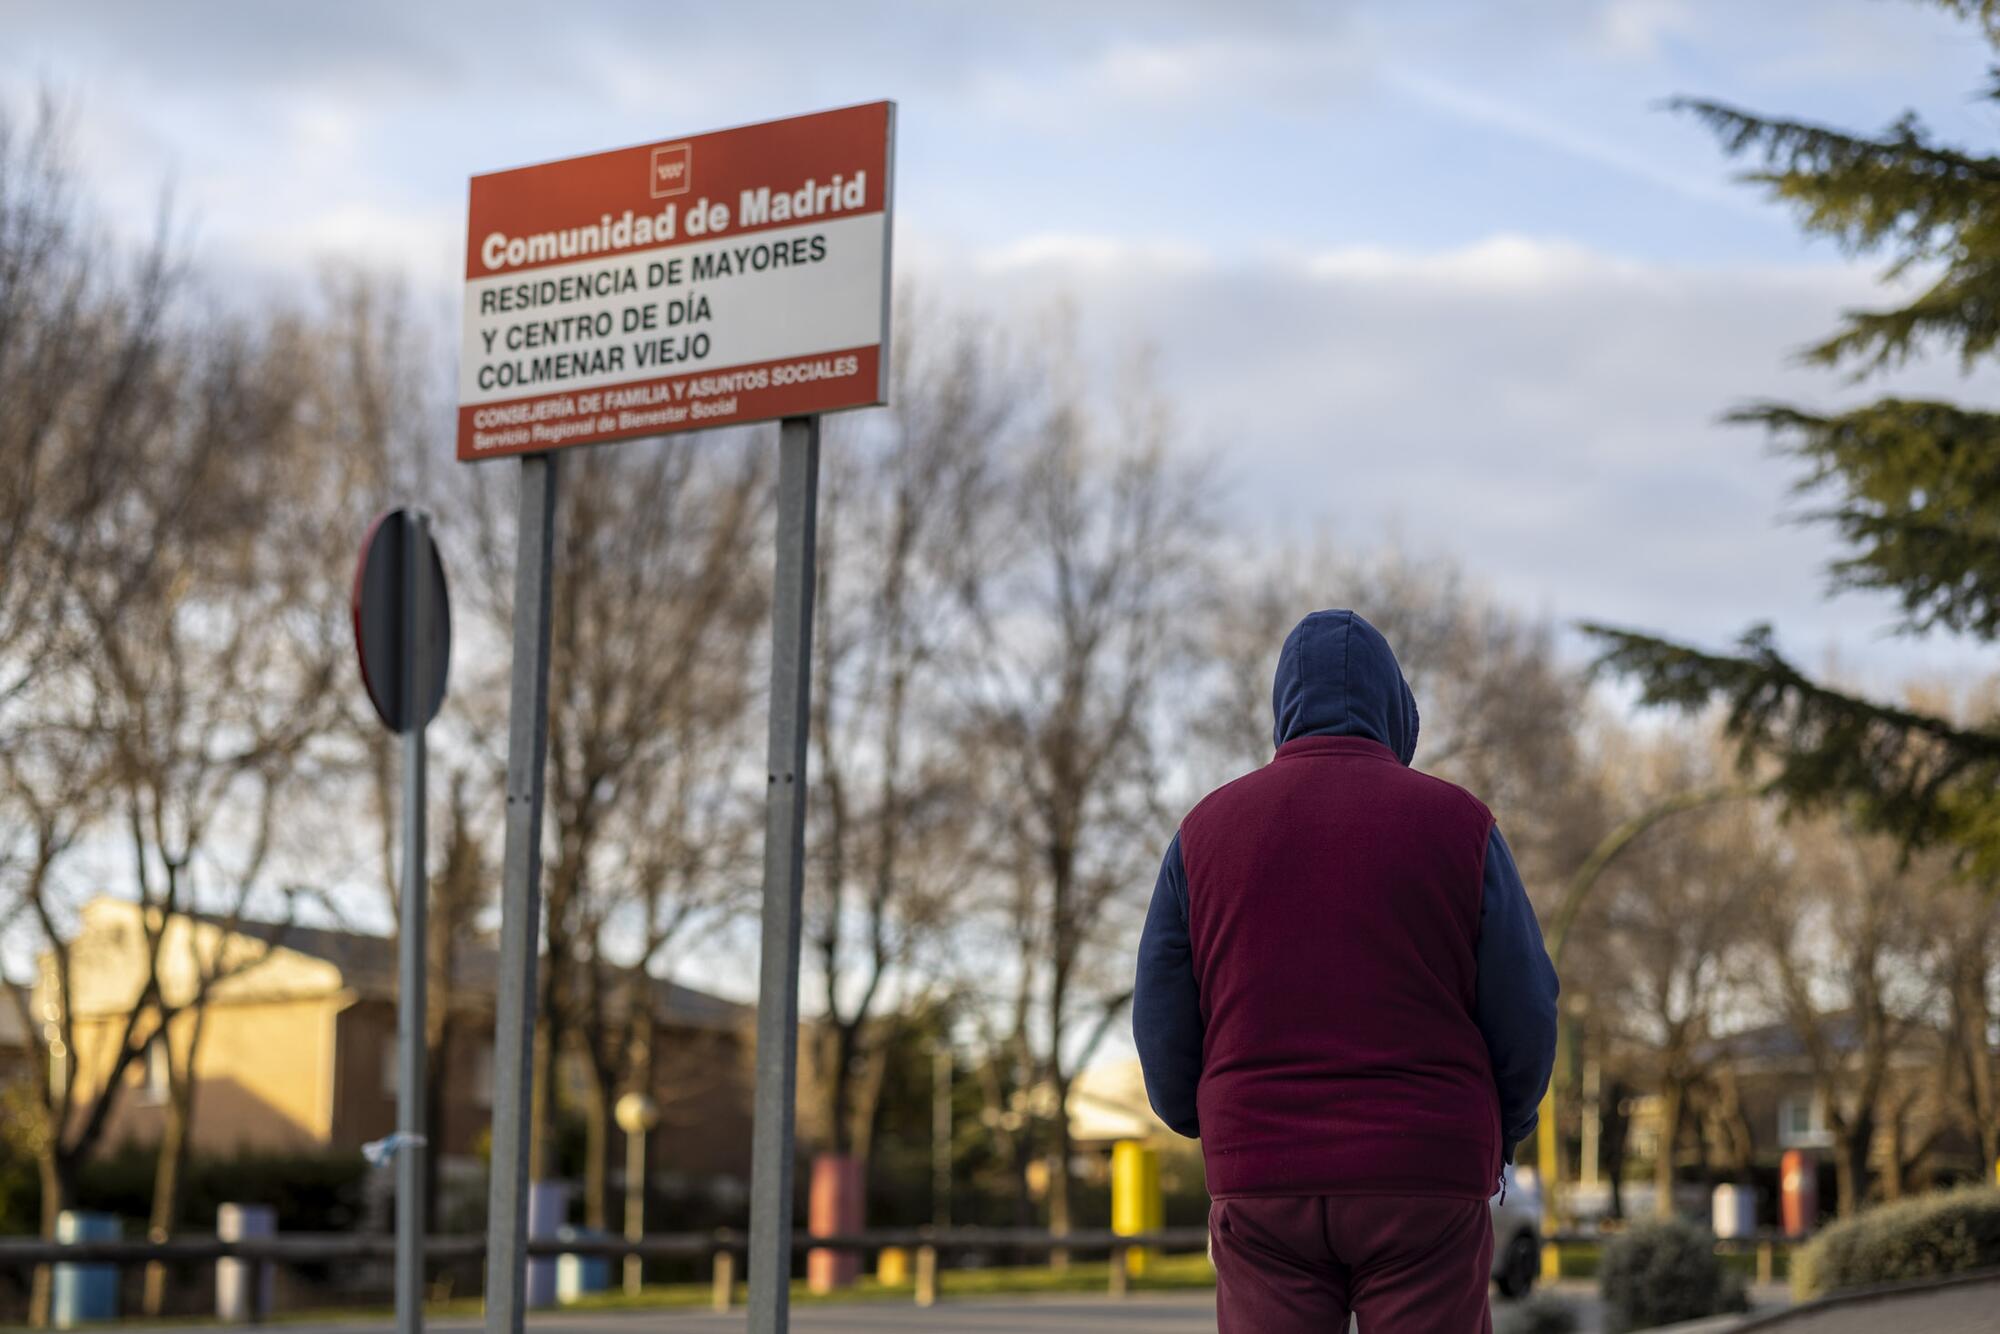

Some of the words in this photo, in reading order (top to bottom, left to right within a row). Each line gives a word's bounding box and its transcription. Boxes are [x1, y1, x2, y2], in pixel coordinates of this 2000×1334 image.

[482, 205, 677, 269] Comunidad
[686, 198, 729, 237] de
[739, 171, 866, 227] Madrid
[481, 267, 637, 316] RESIDENCIA
[648, 259, 682, 288] DE
[692, 236, 826, 282] MAYORES
[482, 330, 497, 354] Y
[506, 312, 612, 350] CENTRO
[624, 304, 657, 332] DE
[669, 292, 711, 324] DÍA
[478, 346, 624, 390] COLMENAR
[635, 334, 710, 367] VIEJO
[580, 394, 601, 415] DE
[605, 384, 670, 411] FAMILIA
[673, 383, 685, 399] Y
[688, 371, 768, 398] ASUNTOS
[772, 356, 857, 385] SOCIALES
[474, 423, 529, 449] Servicio
[533, 413, 595, 444] Regional
[599, 411, 616, 431] de
[620, 402, 687, 429] Bienestar
[691, 398, 736, 419] Social
